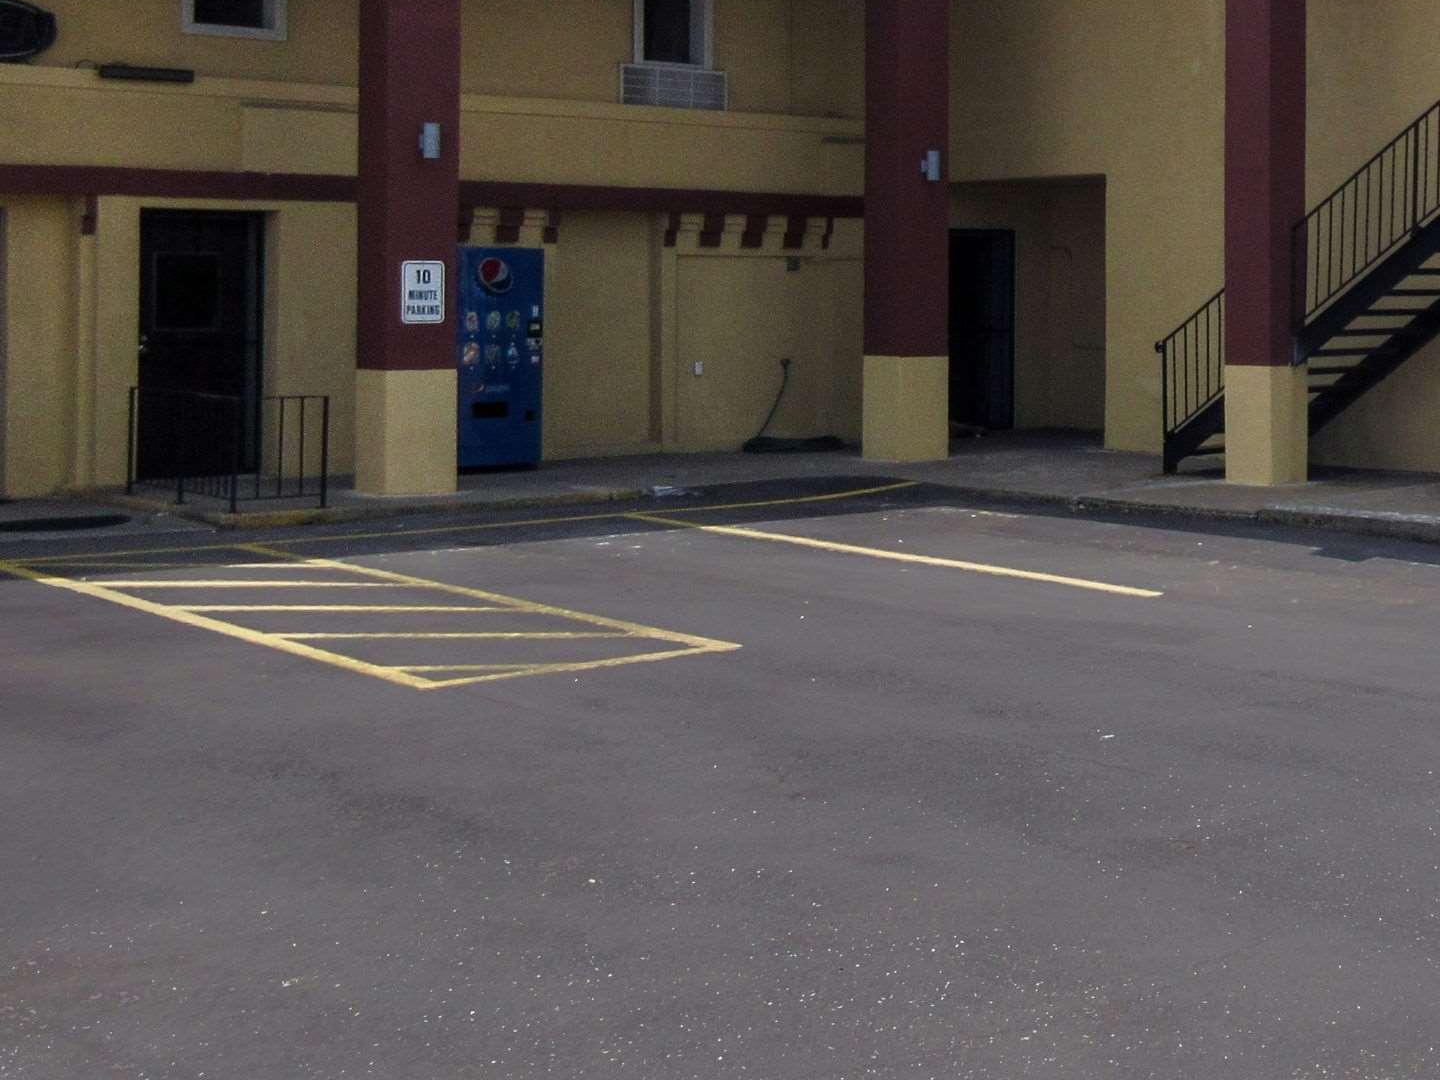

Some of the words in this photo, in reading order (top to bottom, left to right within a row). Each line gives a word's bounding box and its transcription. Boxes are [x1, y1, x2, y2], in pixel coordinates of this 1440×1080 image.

[416, 269, 431, 284] 10
[409, 290, 438, 301] MINUTE
[407, 305, 440, 316] PARKING
